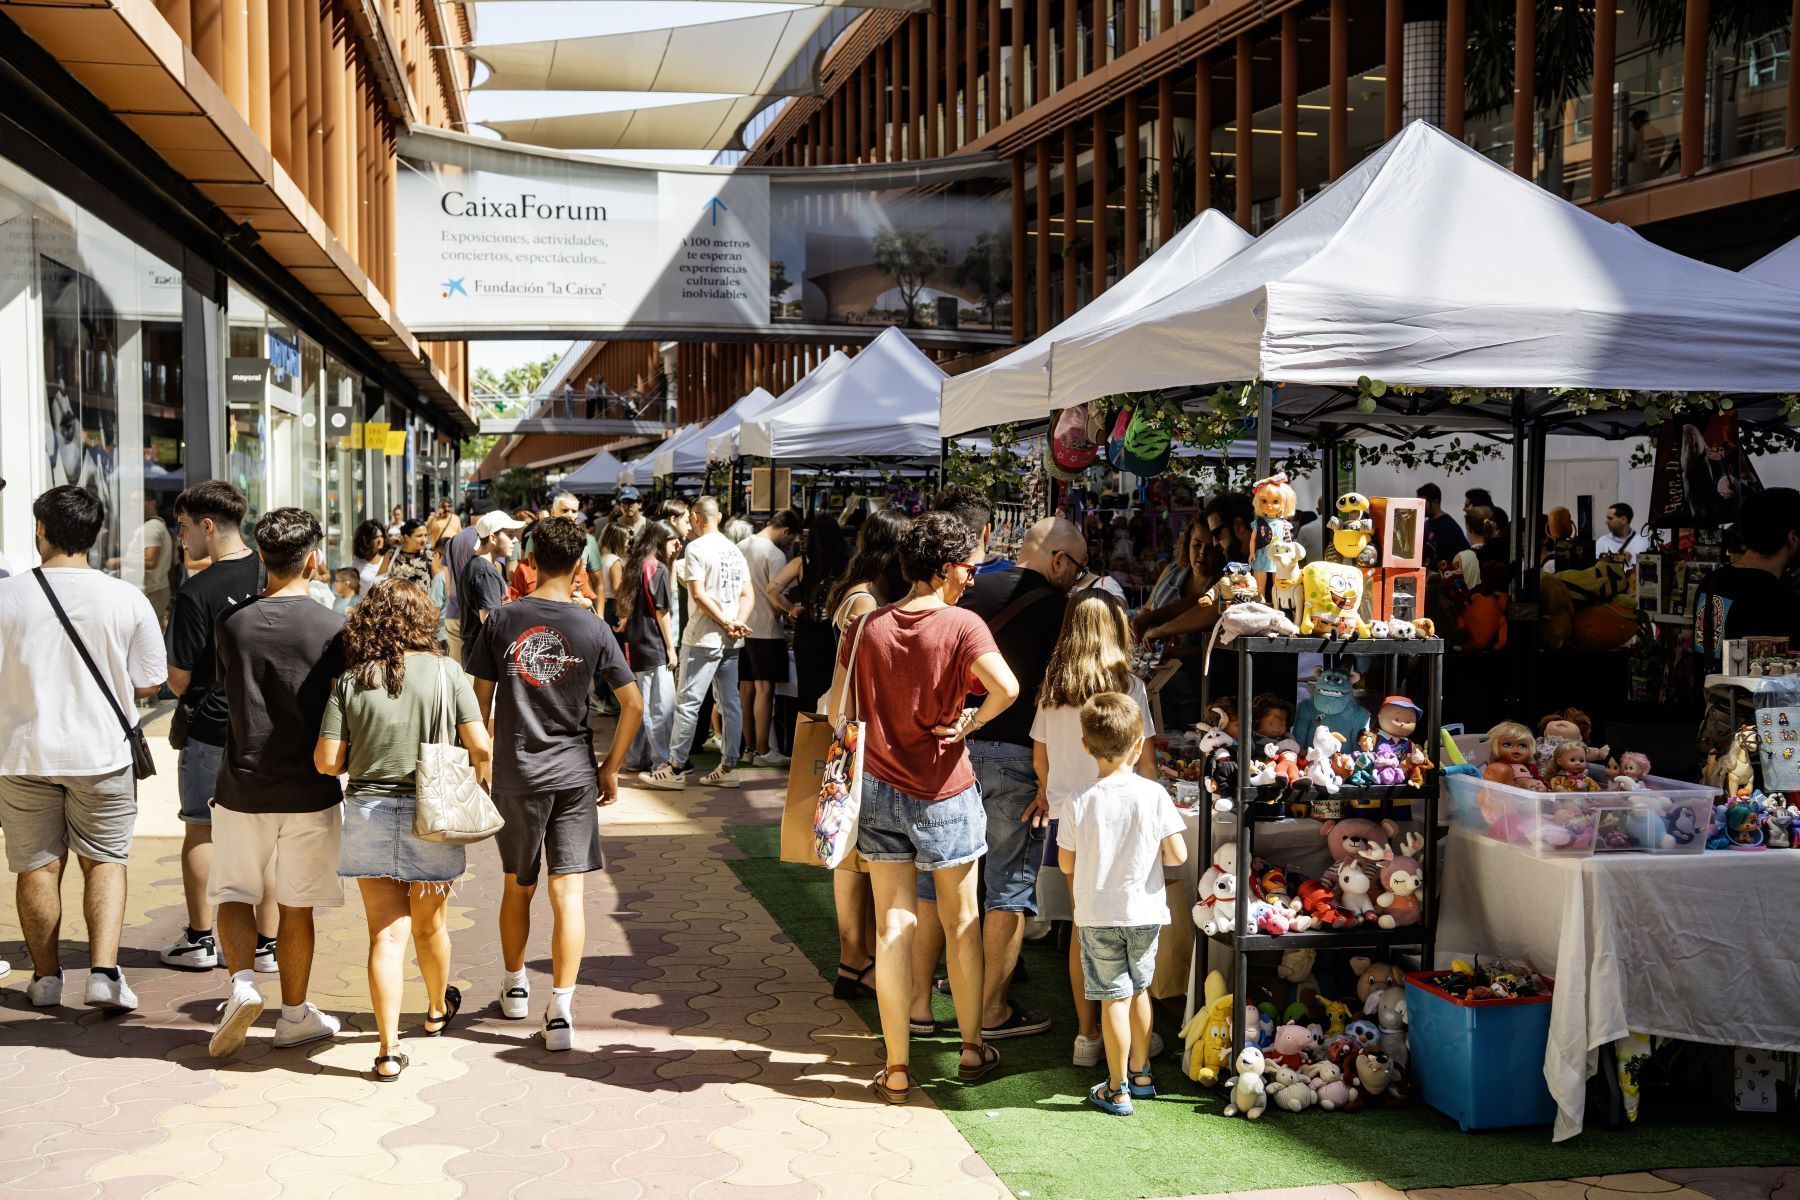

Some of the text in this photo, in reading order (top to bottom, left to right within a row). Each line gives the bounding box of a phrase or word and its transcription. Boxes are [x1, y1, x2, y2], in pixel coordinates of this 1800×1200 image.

[441, 191, 607, 221] CaixaForum
[441, 230, 608, 247] Exposiciones, actividades,
[691, 237, 711, 247] 100
[713, 240, 751, 249] metros
[441, 250, 513, 263] conciertos,
[687, 251, 742, 262] te esperan
[679, 263, 748, 275] experiencias
[475, 280, 544, 294] Fundación
[686, 276, 741, 286] culturales
[682, 288, 748, 299] inolvidables
[503, 641, 584, 663] McKenzie
